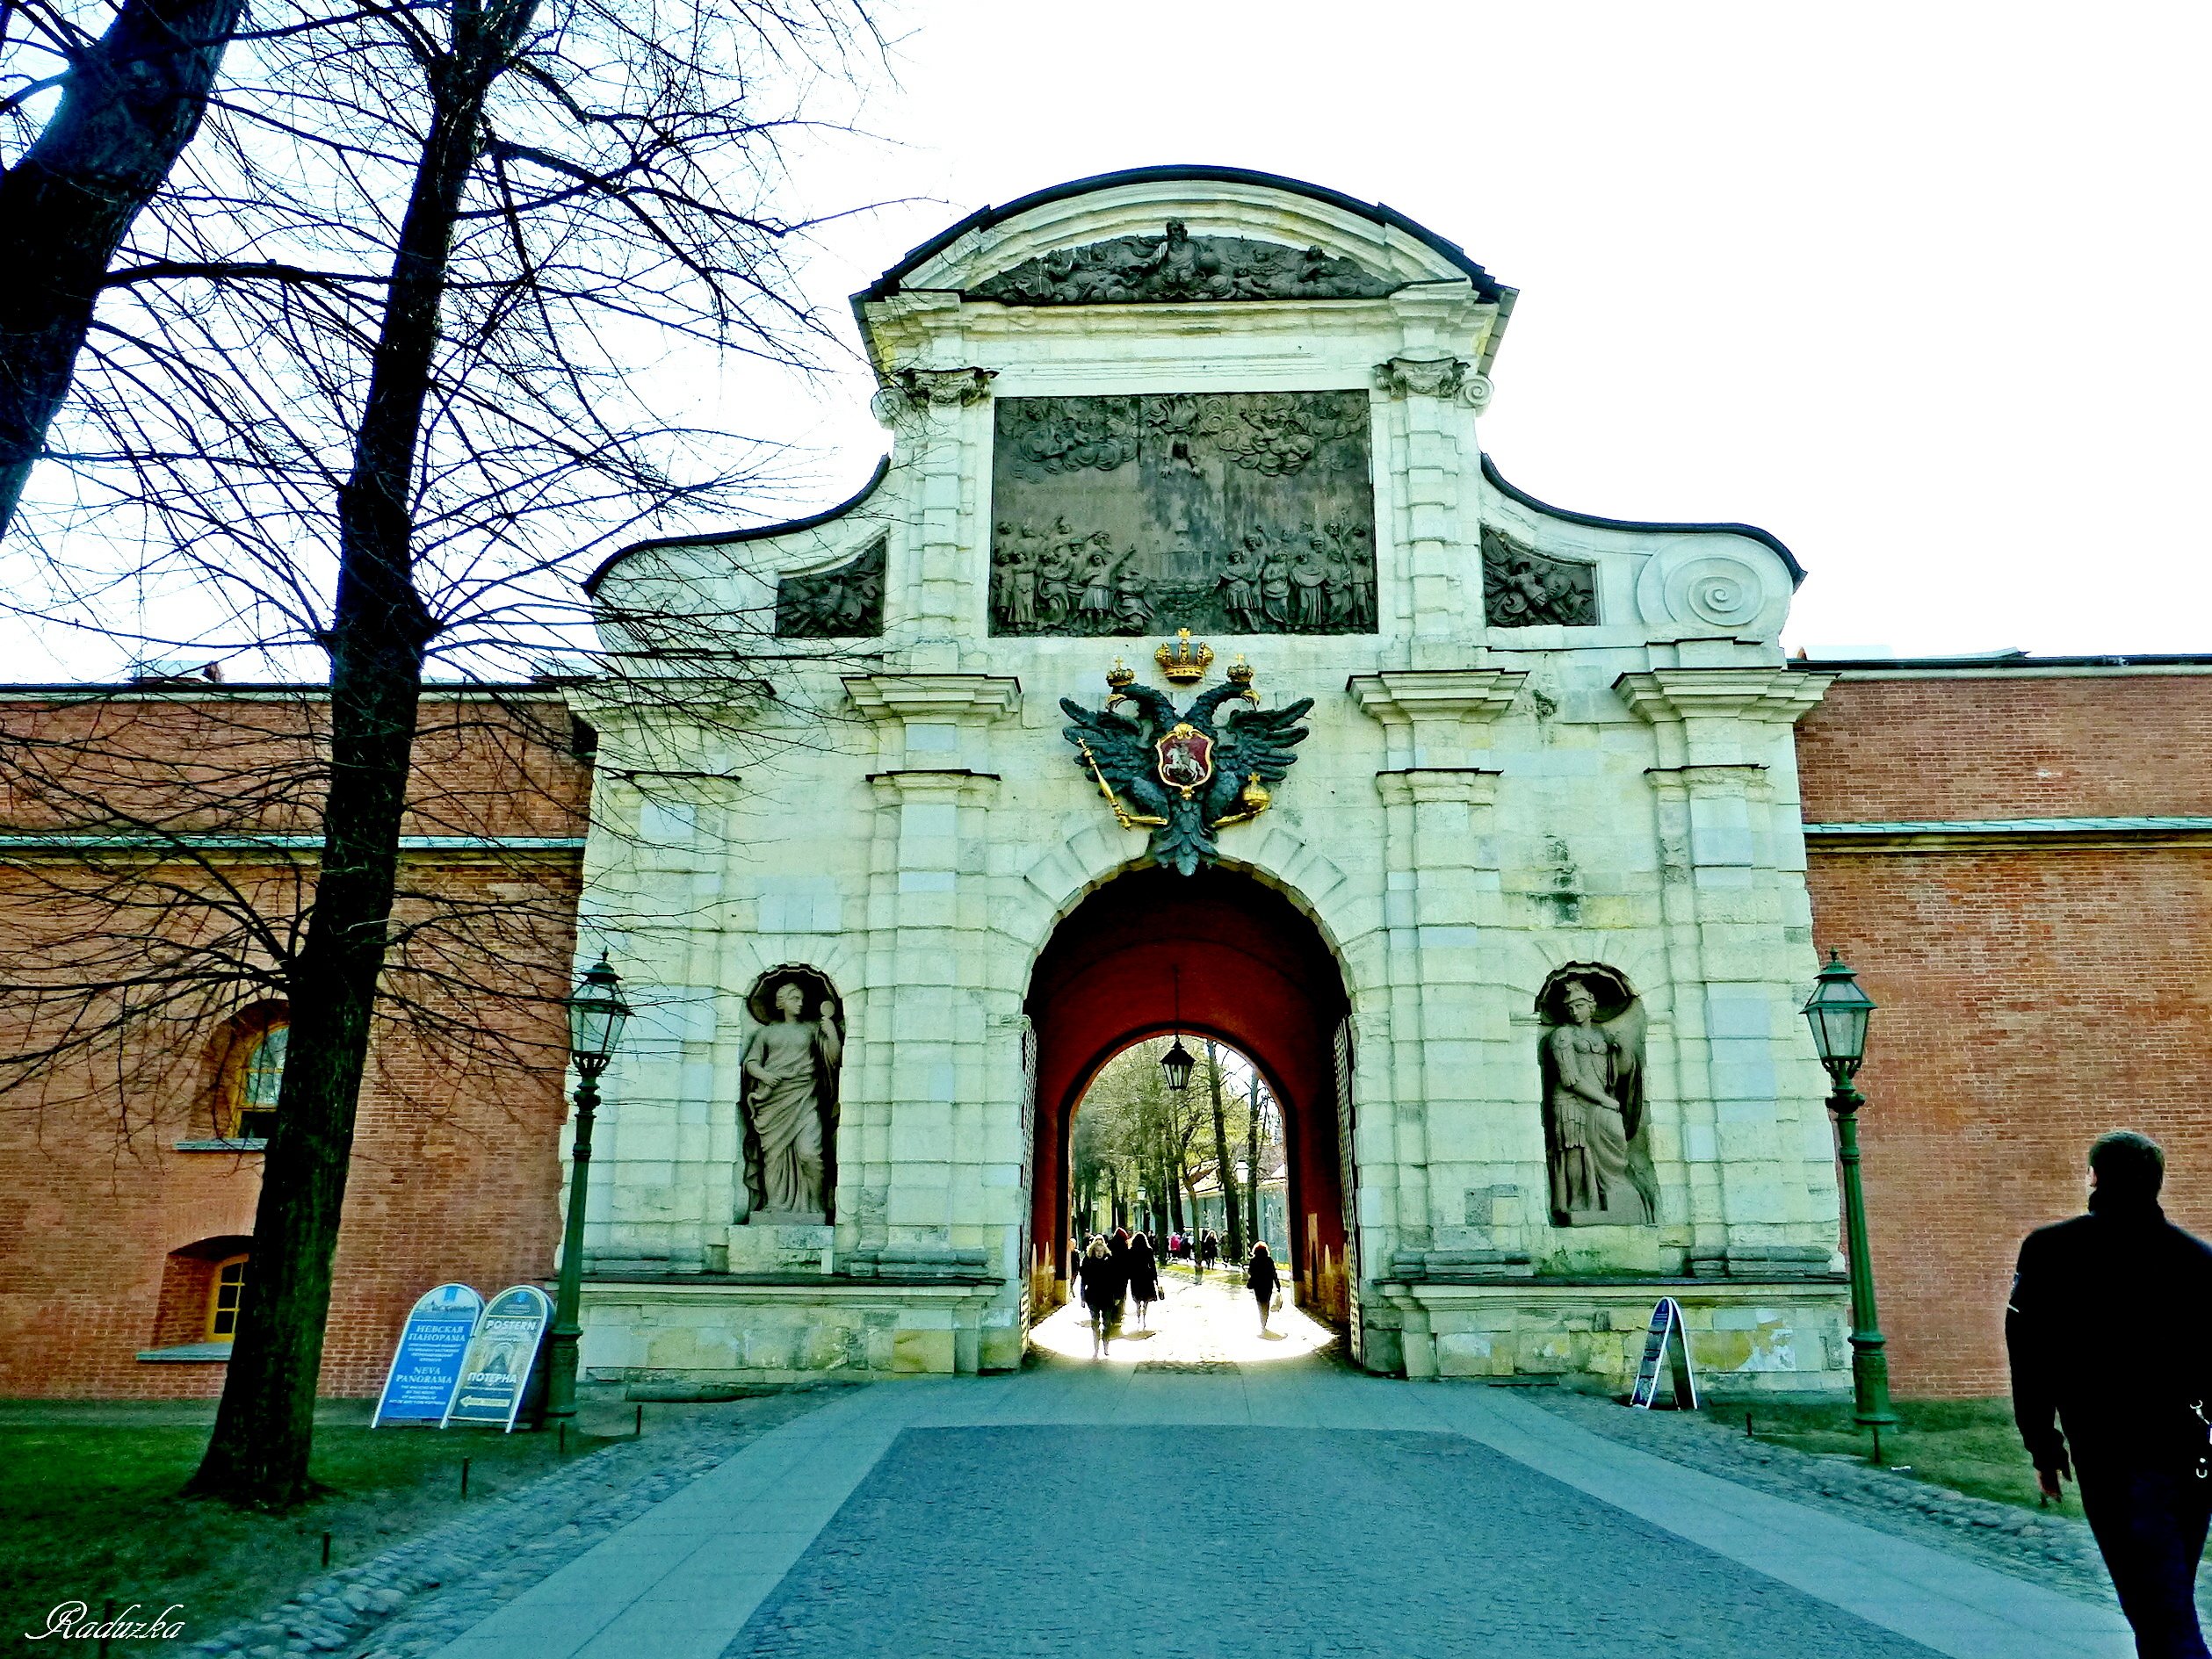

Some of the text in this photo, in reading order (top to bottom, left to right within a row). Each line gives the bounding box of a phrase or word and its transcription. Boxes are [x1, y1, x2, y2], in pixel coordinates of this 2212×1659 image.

[416, 1324, 465, 1333] НЕВСКАЯ
[485, 1320, 537, 1331] POSTERN
[408, 1333, 466, 1342] ПАНОРАМА
[395, 1374, 452, 1383] PANORAMA
[467, 1372, 517, 1383] ПОТЕРНА
